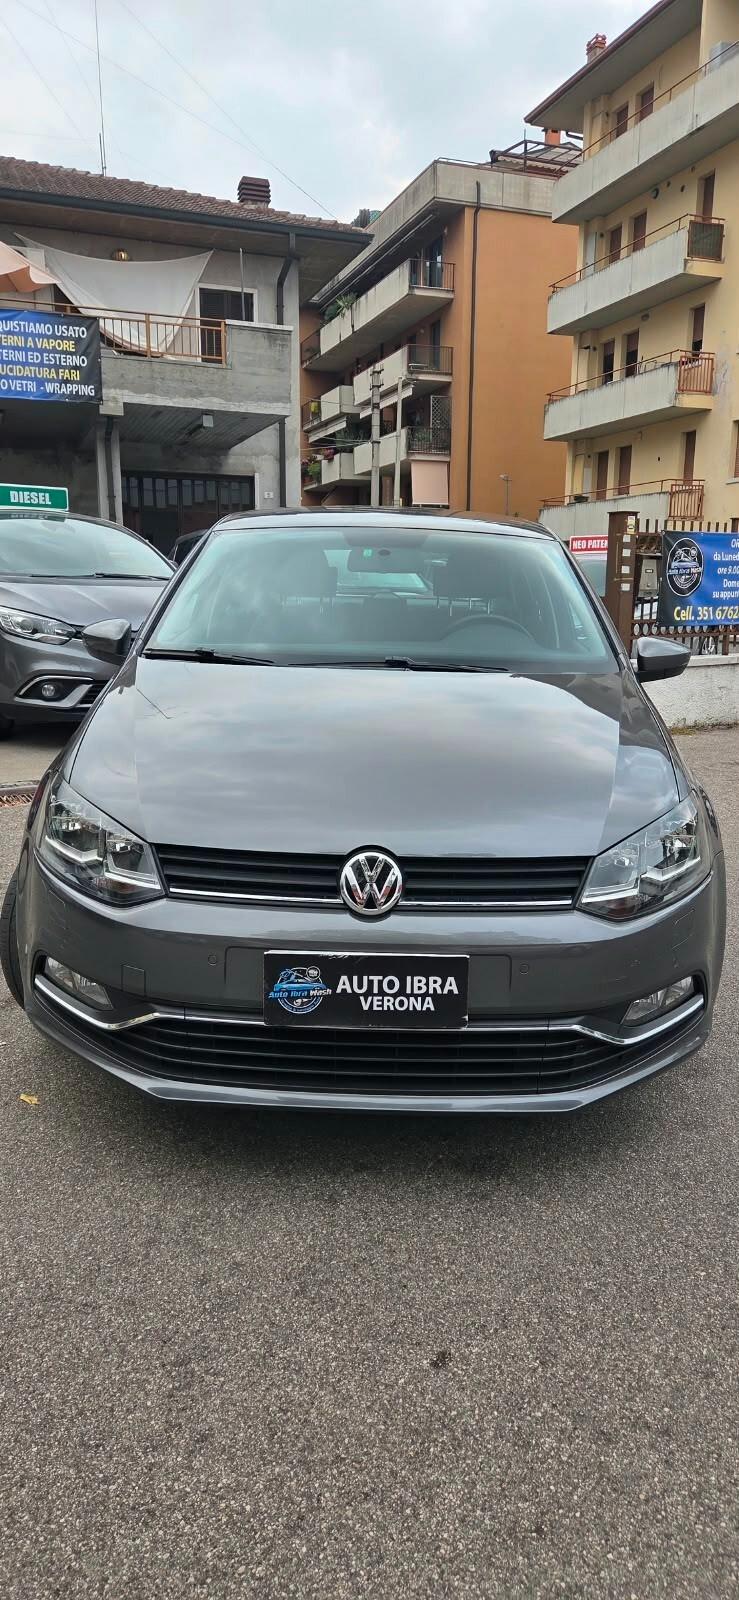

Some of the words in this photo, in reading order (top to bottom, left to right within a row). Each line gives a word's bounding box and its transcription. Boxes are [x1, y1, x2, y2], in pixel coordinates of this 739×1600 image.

[55, 325, 87, 338] USATO
[27, 336, 34, 348] A
[36, 338, 76, 352] VAPORE
[28, 352, 41, 364] ED
[43, 353, 88, 367] ESTERNO
[59, 369, 80, 381] FARI
[9, 379, 37, 393] VETRI
[10, 490, 52, 505] DIESEL
[572, 540, 587, 549] NEO
[713, 552, 721, 561] da
[712, 591, 720, 599] su
[720, 590, 739, 600] appun
[674, 606, 694, 620] Cell.
[697, 606, 713, 620] 351
[336, 975, 400, 994] AUTO
[405, 975, 459, 995] IBRA
[268, 990, 288, 998] Auto
[310, 988, 332, 996] Wash
[359, 996, 435, 1012] VERONA
